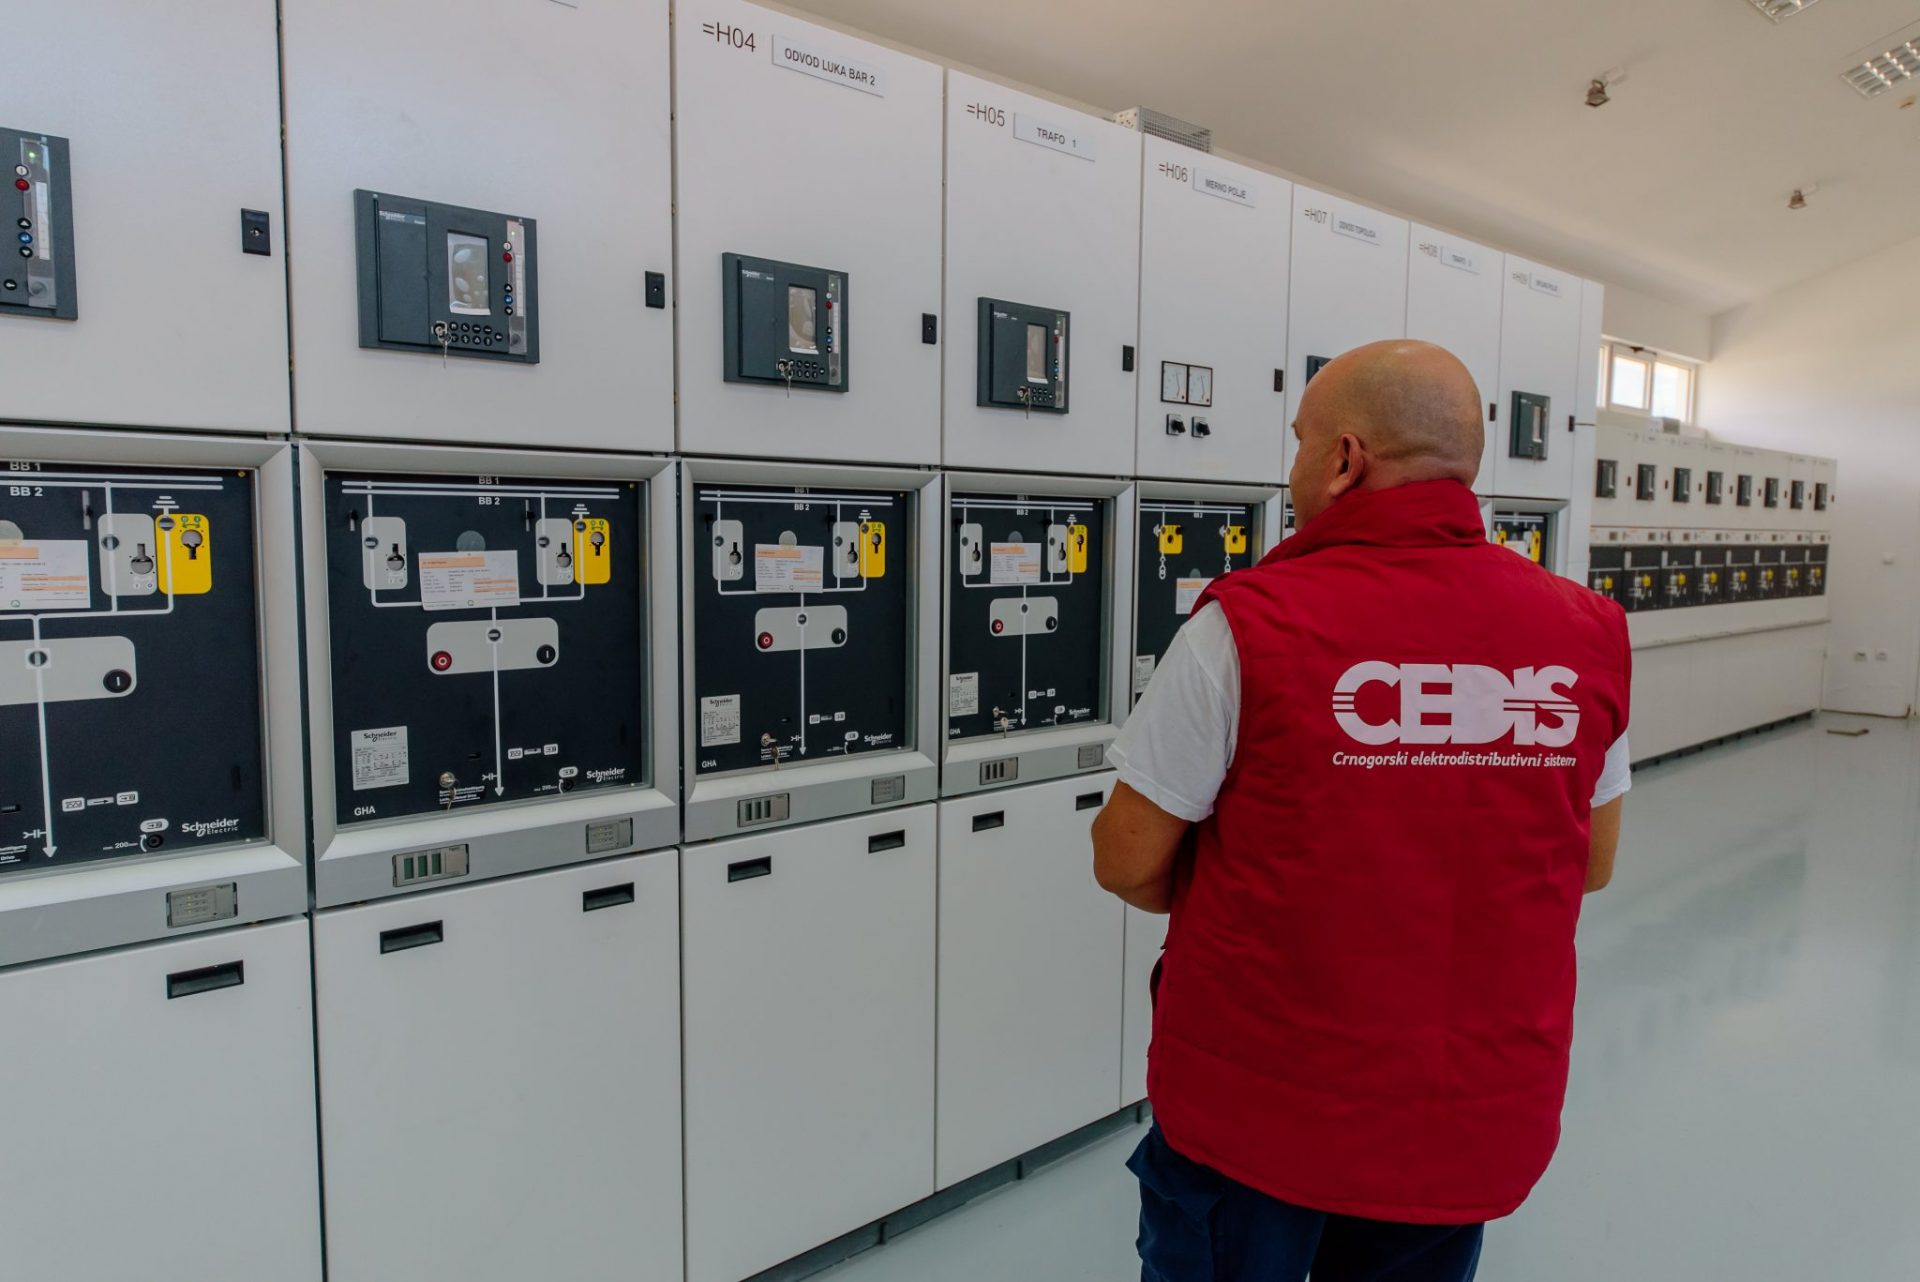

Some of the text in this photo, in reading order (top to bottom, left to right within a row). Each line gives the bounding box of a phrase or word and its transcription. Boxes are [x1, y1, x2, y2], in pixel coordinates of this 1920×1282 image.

[702, 21, 756, 53] =H04
[784, 47, 876, 86] ODVOD LUKA BAR 2
[966, 102, 1006, 127] =H05
[1036, 127, 1077, 148] TRAFO 1
[9, 460, 31, 472] BB
[478, 474, 492, 485] BB
[9, 486, 44, 497] BB 2
[478, 496, 501, 506] BB 2
[1332, 660, 1581, 748] CEDIS
[701, 760, 717, 769] GHA
[1332, 751, 1577, 769] Crnogorski elektrodistributivni sistem
[586, 767, 626, 783] Schneider
[353, 805, 377, 817] GHA
[181, 818, 240, 837] Schneider
[206, 826, 239, 836] Electric
